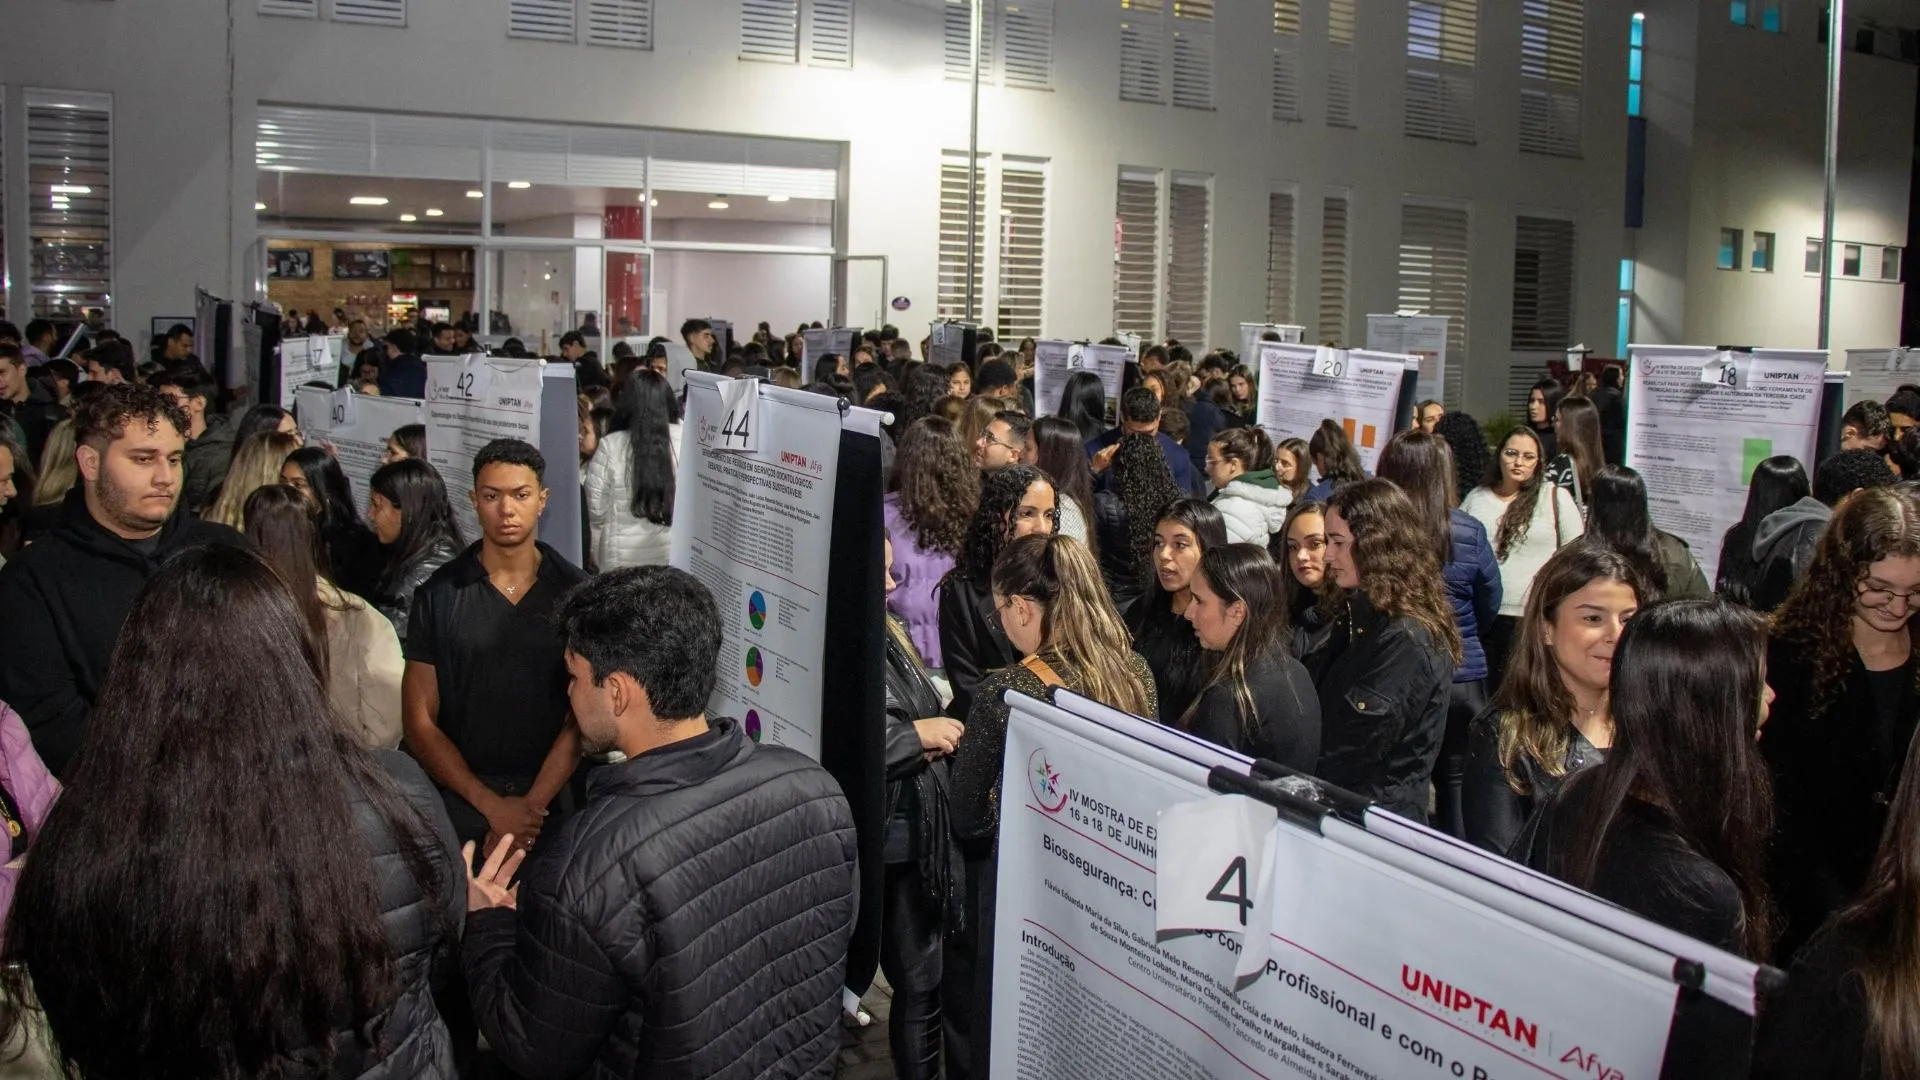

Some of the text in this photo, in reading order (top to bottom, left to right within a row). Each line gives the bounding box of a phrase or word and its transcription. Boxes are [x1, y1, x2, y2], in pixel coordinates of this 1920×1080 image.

[456, 371, 474, 397] 42
[1322, 360, 1342, 377] 20
[1718, 365, 1737, 385] 18
[1764, 372, 1799, 380] UNIPTAN
[332, 404, 345, 424] 40
[499, 397, 522, 407] UNIPTAN
[721, 409, 750, 448] 44
[781, 450, 807, 468] UNIPTAN
[1069, 788, 1079, 802] IV
[1081, 794, 1125, 826] MOSTRA
[1128, 816, 1143, 835] DE
[1069, 806, 1157, 859] 16 a 18 DE JUNH
[1043, 833, 1137, 901] Biossegurança:
[1206, 855, 1254, 927] 4
[1021, 929, 1076, 972] Introdução
[1061, 889, 1084, 910] Eduarda
[1084, 904, 1103, 922] Maria
[1103, 916, 1112, 928] da
[1113, 921, 1131, 939] Silva,
[1131, 932, 1161, 956] Gabriela
[1162, 949, 1181, 967] Melo
[1182, 960, 1216, 987] Resende,
[1260, 1011, 1272, 1025] de
[1273, 1018, 1300, 1040] Melo,
[1302, 1032, 1335, 1060] Isadora
[1090, 920, 1098, 932] de
[1099, 926, 1118, 944] Souza
[1118, 938, 1151, 962] Monteiro
[1152, 956, 1179, 980] Lobato,
[1180, 973, 1202, 993] Maria
[1203, 985, 1221, 1005] Clara
[1221, 1001, 1230, 1012] de
[1230, 1006, 1262, 1034] Carvalho
[1263, 1028, 1316, 1064] Margalhães
[1127, 956, 1151, 976] Centro
[1152, 970, 1197, 1004] Universitário
[1231, 1022, 1267, 1053] Tancredo
[1267, 1047, 1279, 1061] de
[1265, 957, 1376, 1031] Profissional
[1381, 1024, 1392, 1040] e
[1399, 1033, 1443, 1069] com
[1451, 1061, 1465, 1078] o
[1401, 963, 1538, 1049] UNIPTAN
